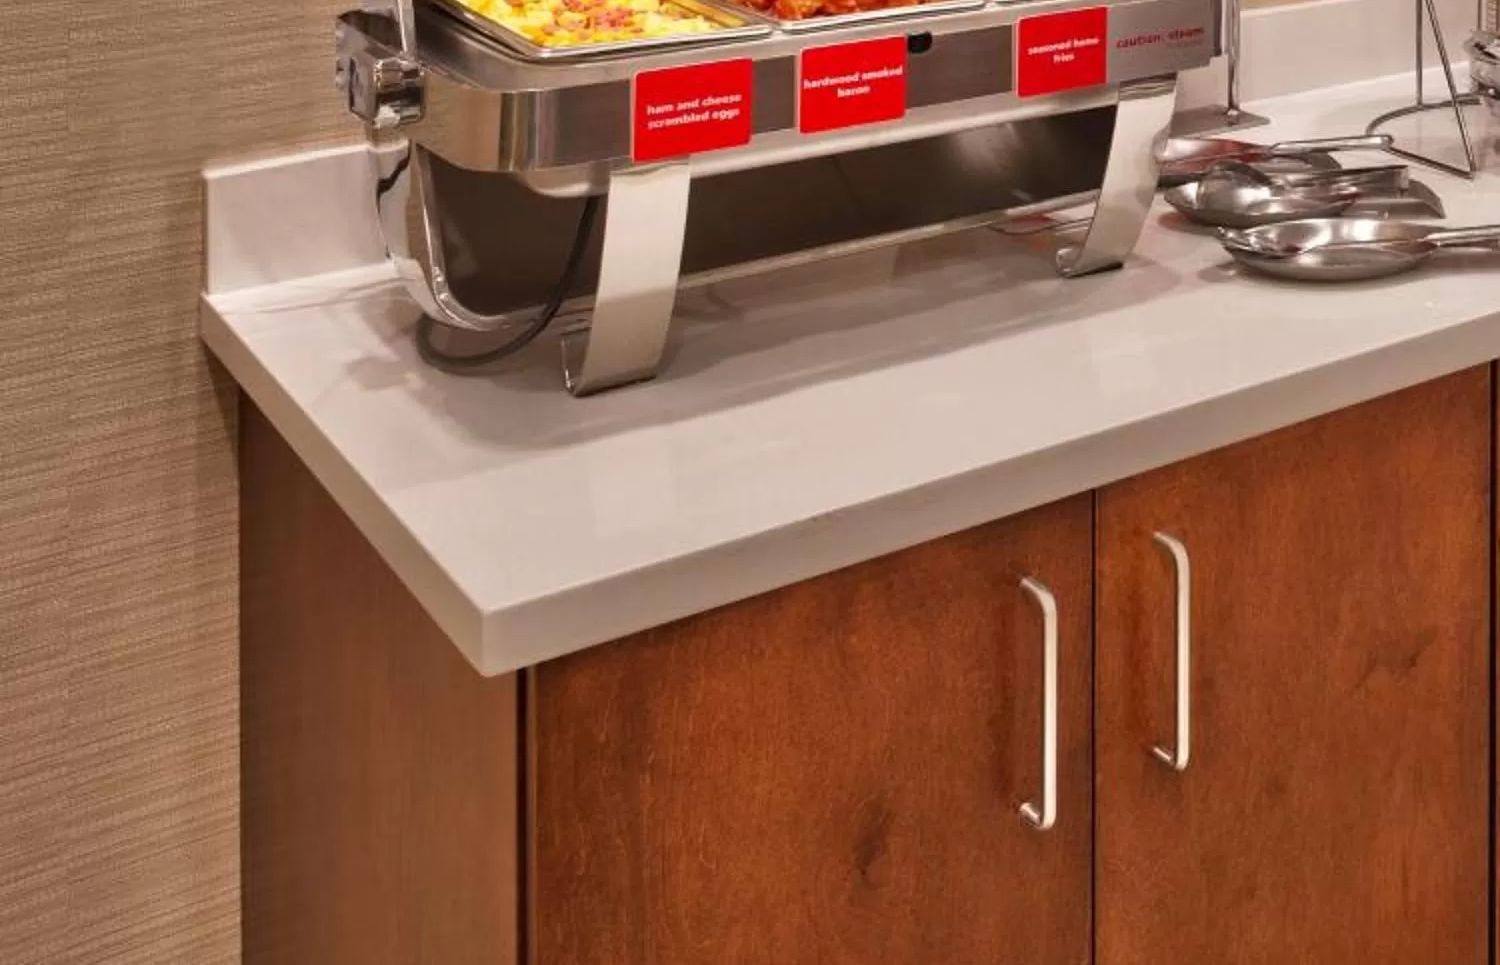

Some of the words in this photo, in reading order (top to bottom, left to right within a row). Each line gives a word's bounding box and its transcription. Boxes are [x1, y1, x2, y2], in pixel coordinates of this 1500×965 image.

[1027, 38, 1072, 55] seasoned
[1073, 36, 1100, 48] home
[803, 71, 860, 90] hardwood
[861, 64, 903, 81] smoked
[837, 85, 871, 98] bacon
[646, 104, 674, 115] ham
[676, 98, 700, 111] and
[701, 94, 743, 106] cheese
[647, 110, 710, 131] scrambled
[711, 107, 740, 121] eggs
